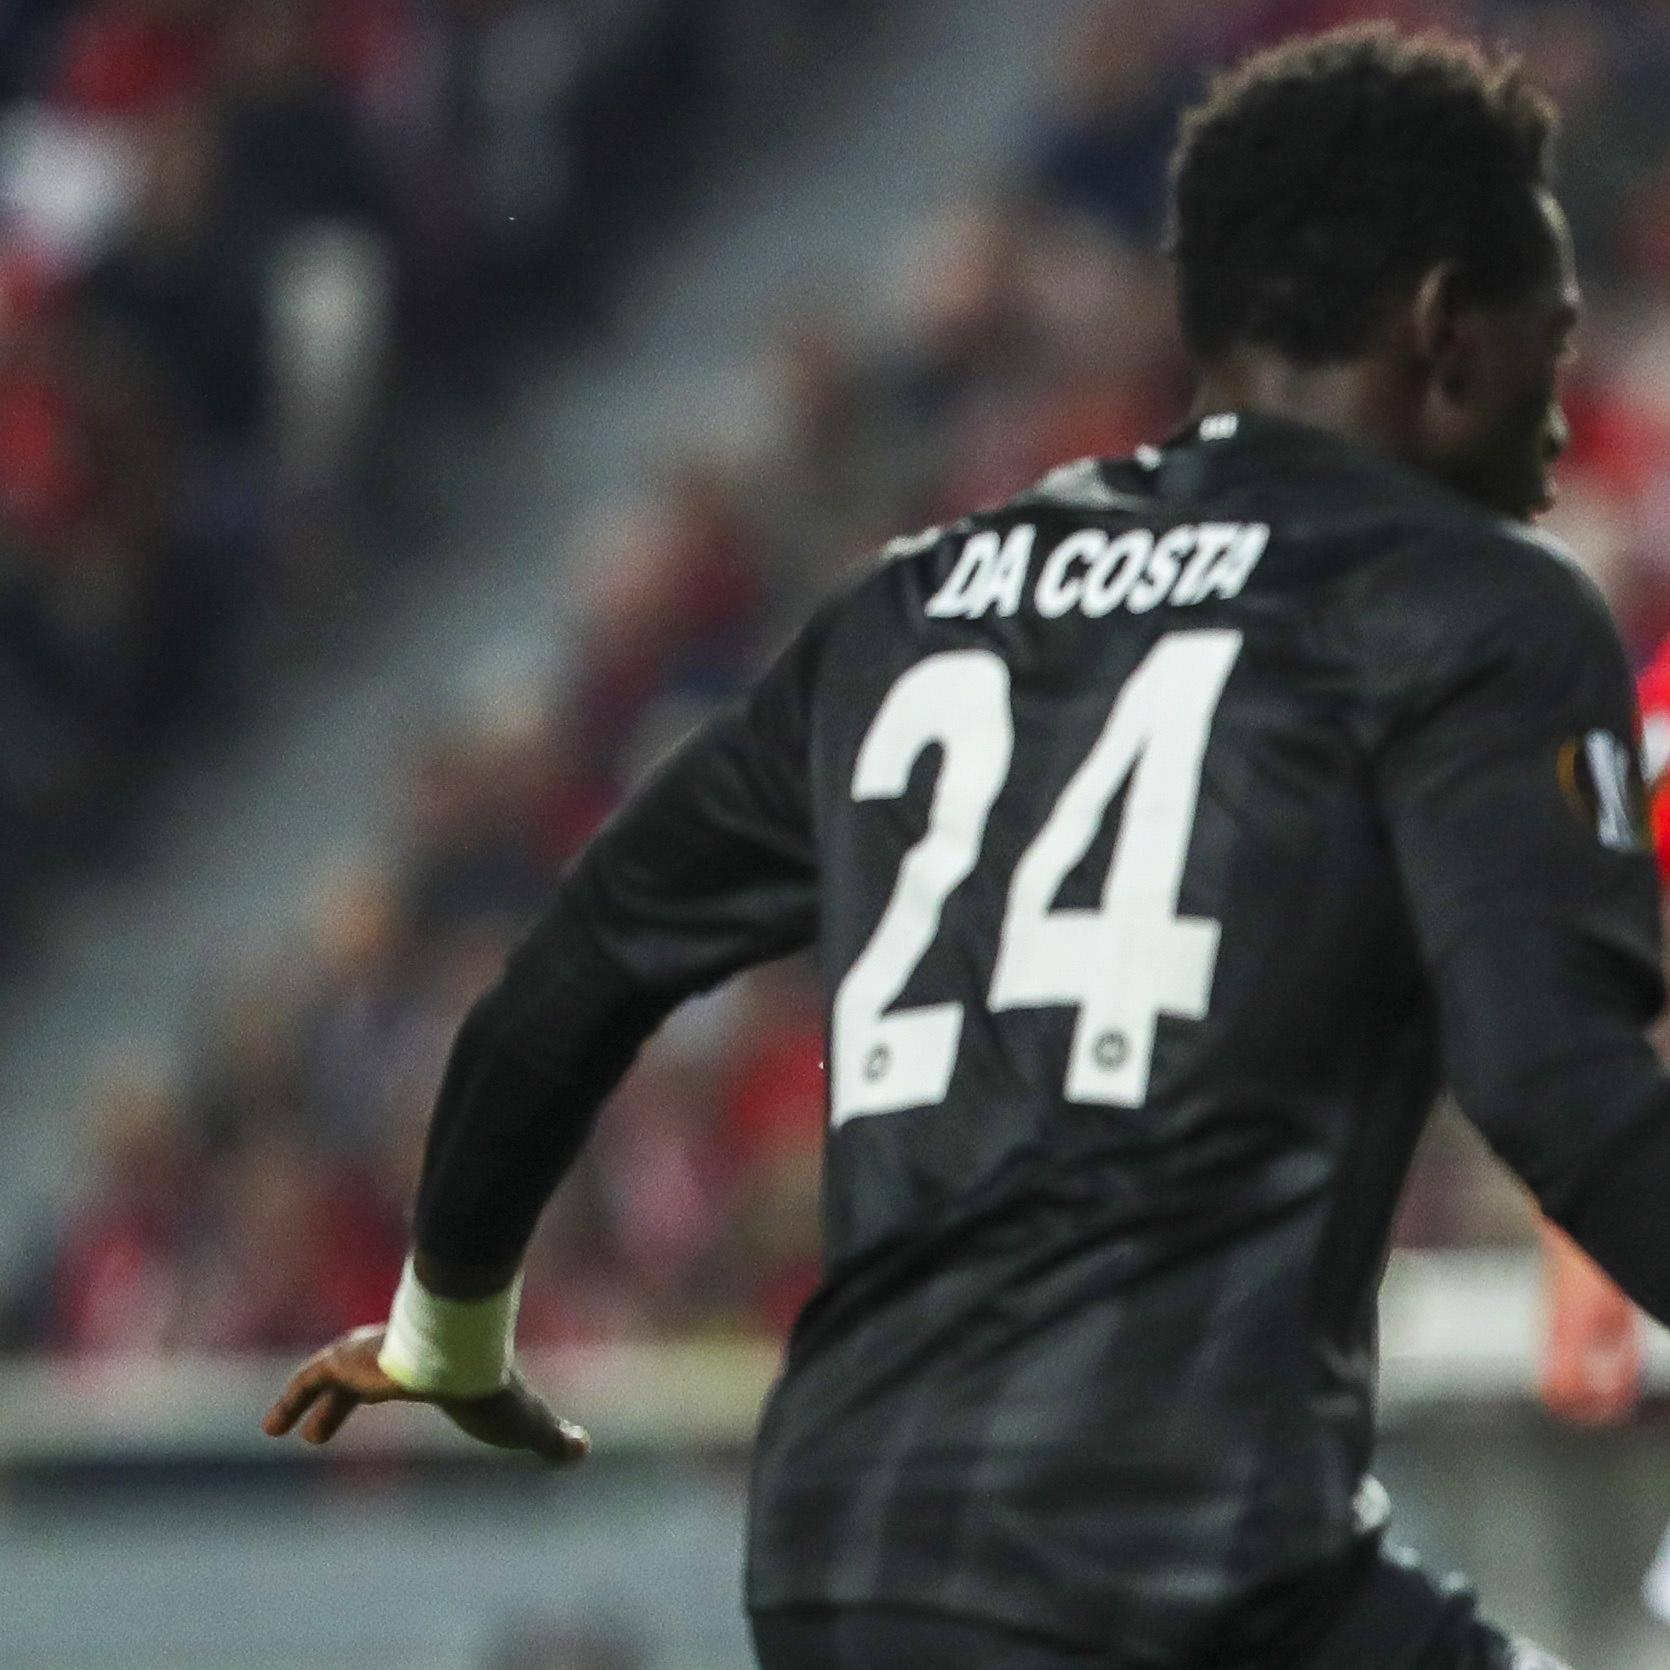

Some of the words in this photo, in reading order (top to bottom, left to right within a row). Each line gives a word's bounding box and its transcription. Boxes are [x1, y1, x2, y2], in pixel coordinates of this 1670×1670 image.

[925, 523, 1035, 619] DA
[1033, 521, 1270, 619] COSTA
[830, 629, 1244, 1127] 24
